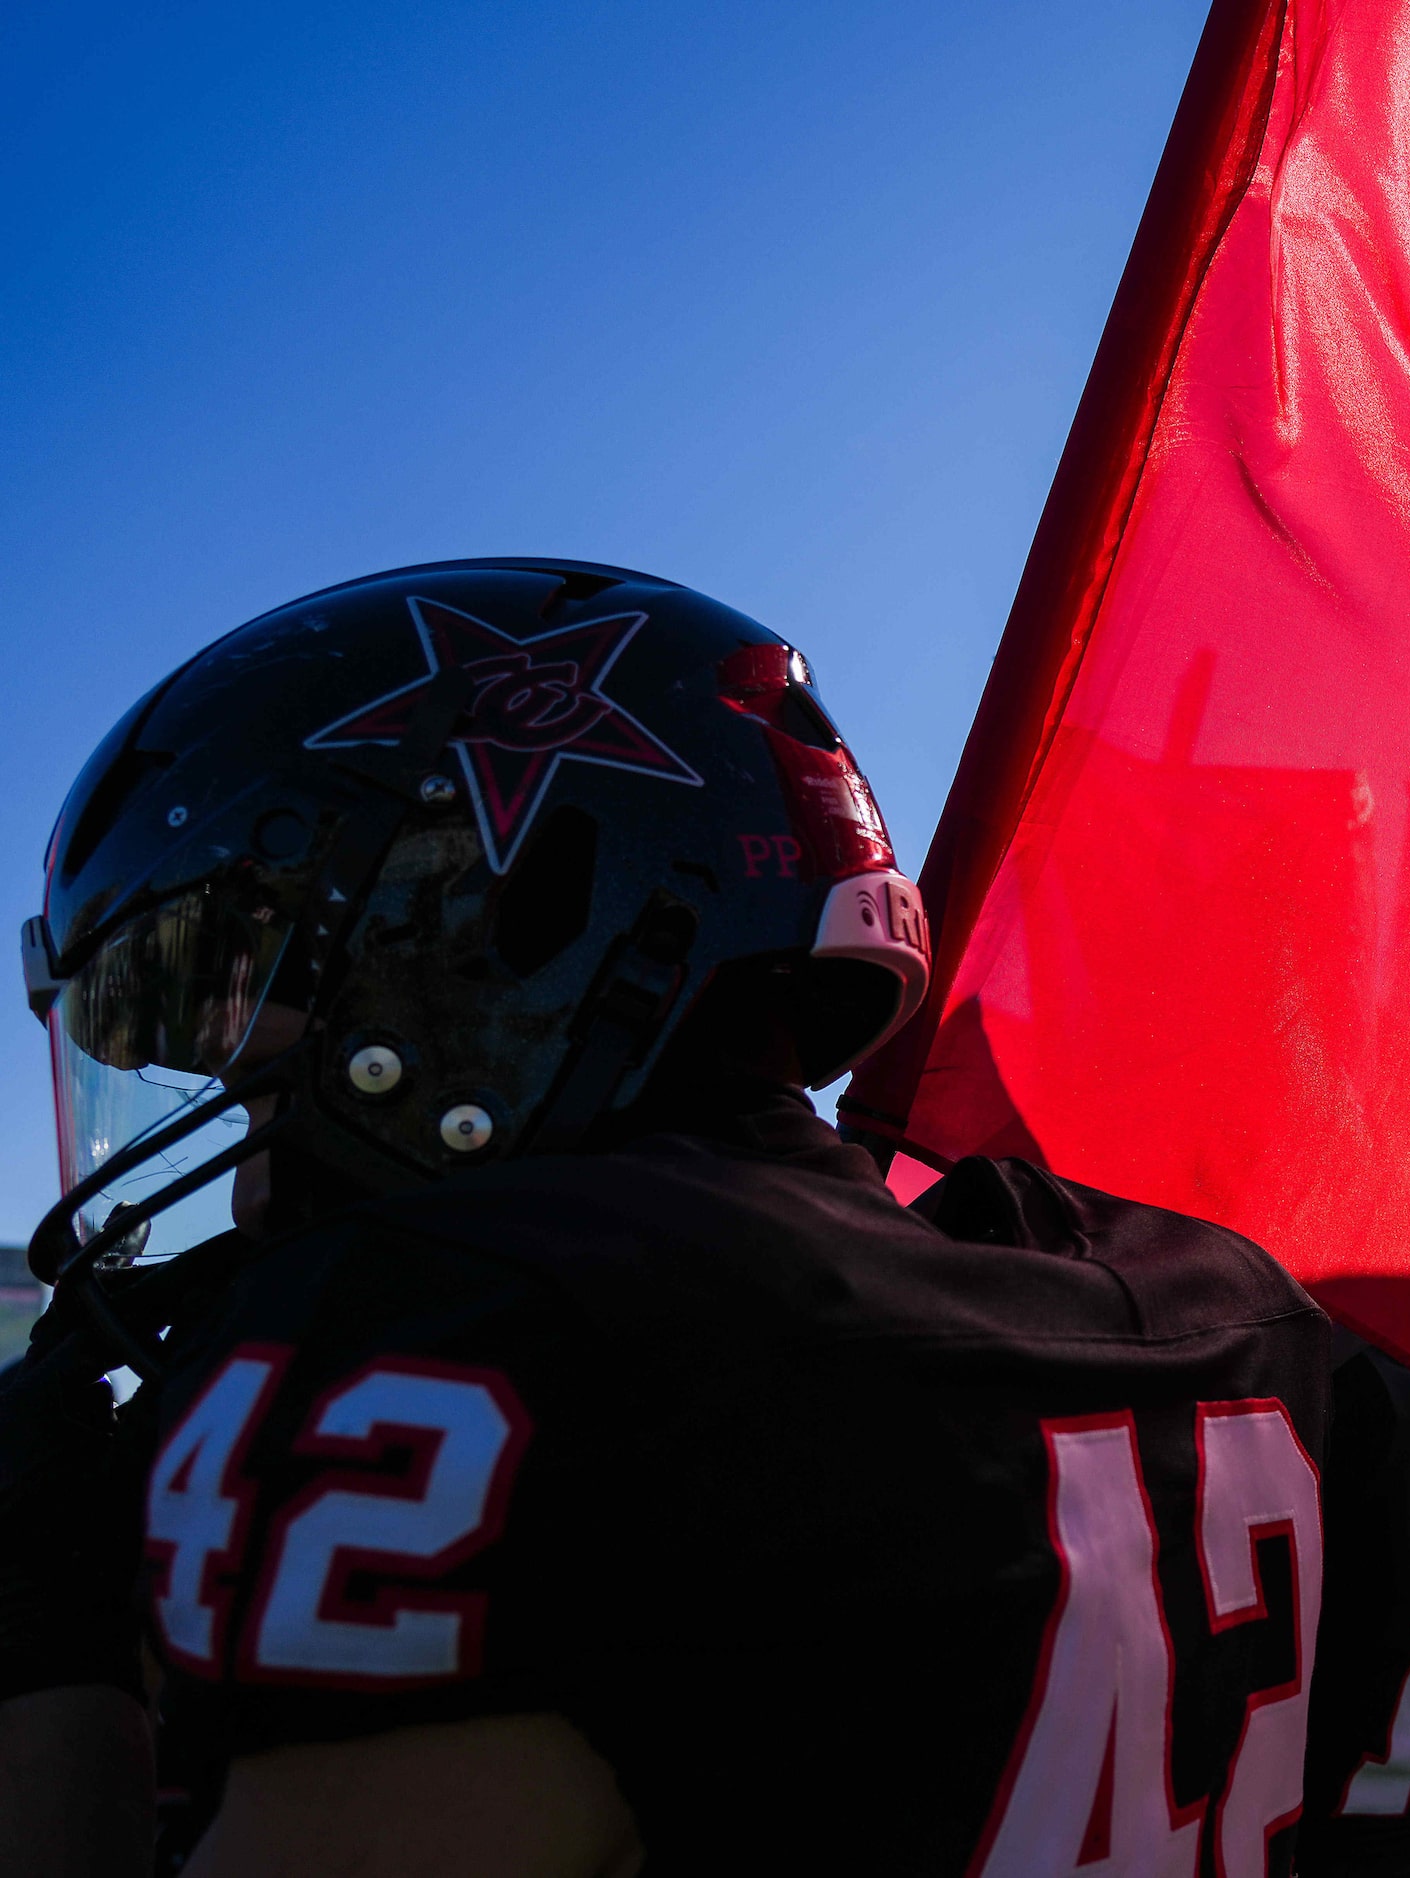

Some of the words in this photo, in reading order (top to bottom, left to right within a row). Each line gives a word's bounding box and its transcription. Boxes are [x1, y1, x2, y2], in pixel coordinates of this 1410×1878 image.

[737, 834, 802, 879] PP
[143, 1339, 536, 1694] 42
[965, 1396, 1324, 1878] 42
